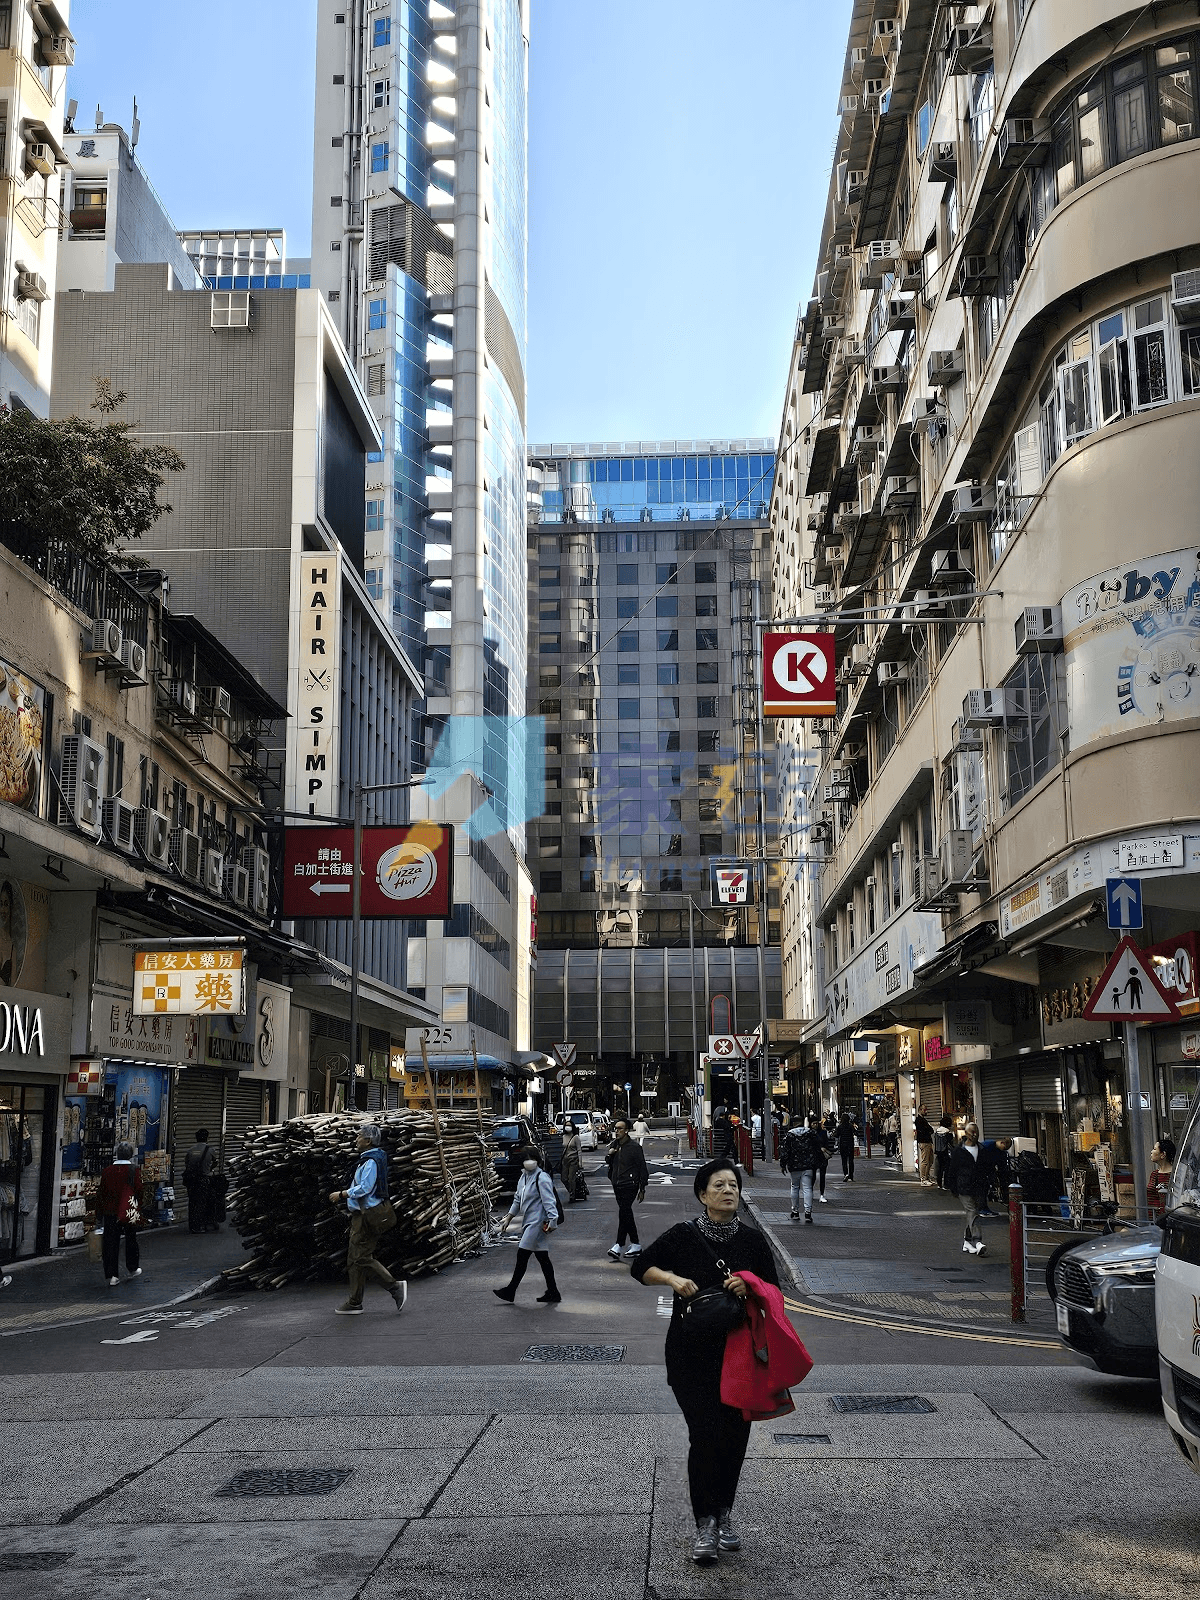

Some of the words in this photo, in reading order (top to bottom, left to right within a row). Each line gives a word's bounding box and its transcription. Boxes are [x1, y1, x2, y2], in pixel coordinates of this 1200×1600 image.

[1075, 566, 1183, 624] Baby
[310, 568, 328, 654] HAIR
[1121, 843, 1148, 851] Parkes
[1153, 838, 1180, 848] Street
[317, 848, 342, 861] 請由
[388, 866, 423, 881] Pizza
[394, 875, 419, 890] Hut
[143, 952, 235, 970] 信安大藥房
[195, 972, 234, 1011] 藥
[423, 1028, 453, 1044] 225
[109, 1036, 119, 1048] TOP
[120, 1038, 135, 1050] GOOD
[136, 1040, 163, 1054] DISPENSARY
[163, 1044, 172, 1055] LTD
[212, 1037, 236, 1062] FAMILY
